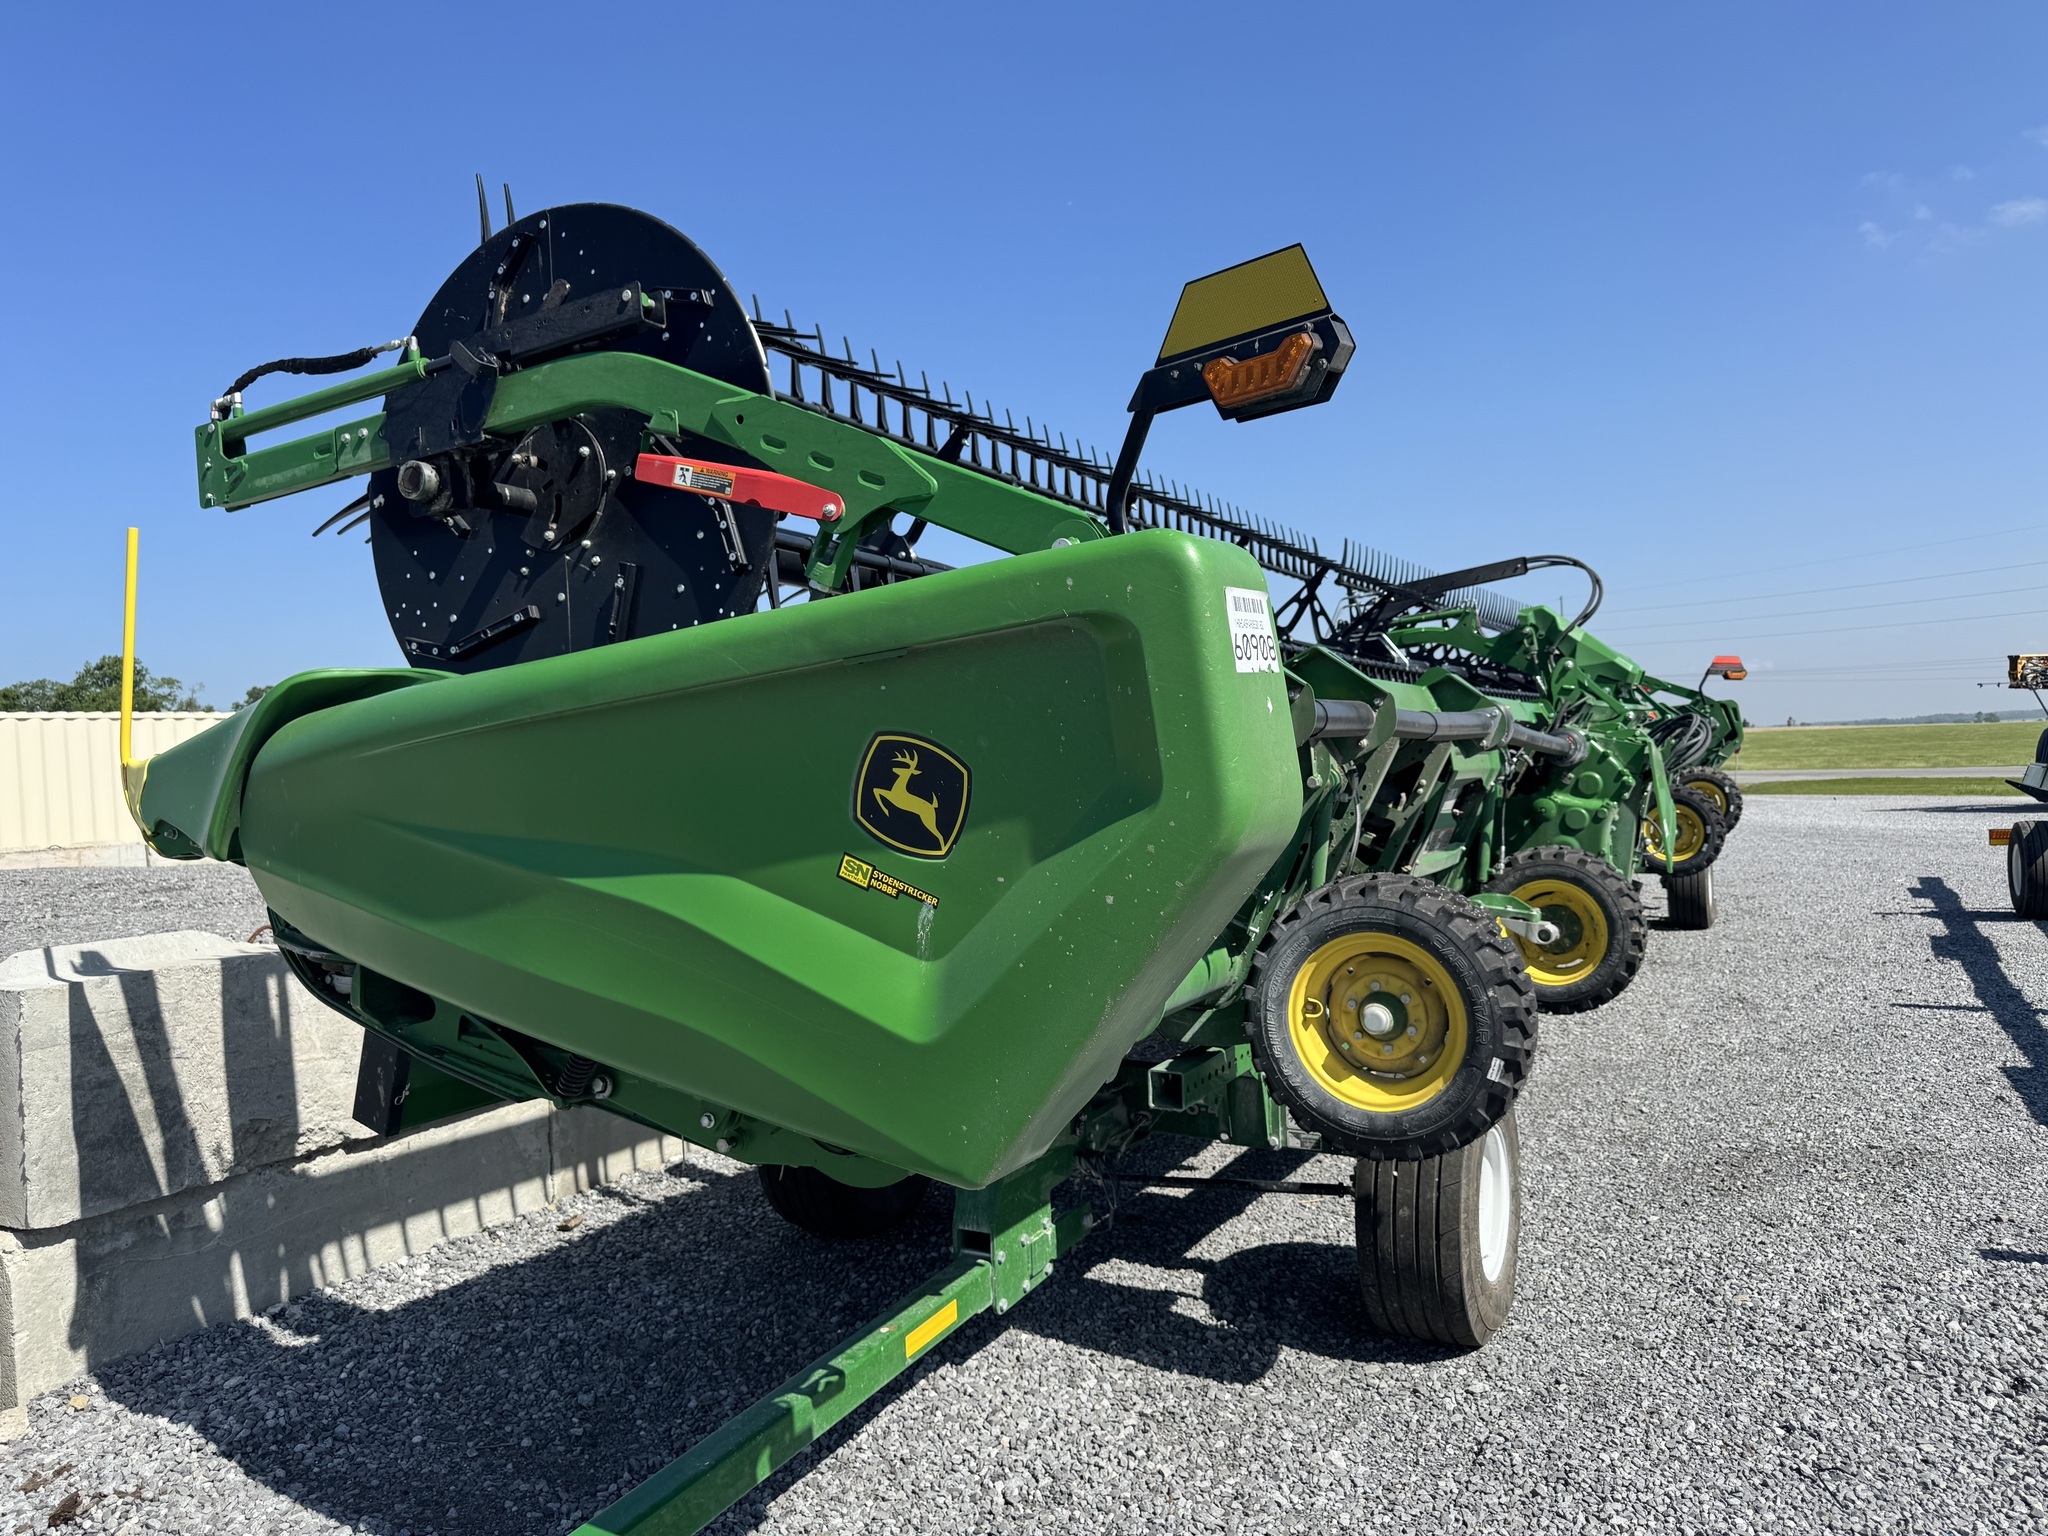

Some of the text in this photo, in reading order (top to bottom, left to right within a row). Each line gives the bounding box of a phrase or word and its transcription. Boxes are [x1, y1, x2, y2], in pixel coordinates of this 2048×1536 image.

[705, 468, 729, 477] WARNING
[1234, 633, 1277, 661] 60908
[841, 870, 867, 885] PARTNERS
[843, 858, 871, 881] SN
[870, 878, 898, 897] NOBBE
[872, 870, 938, 906] SYDENSTRICKER
